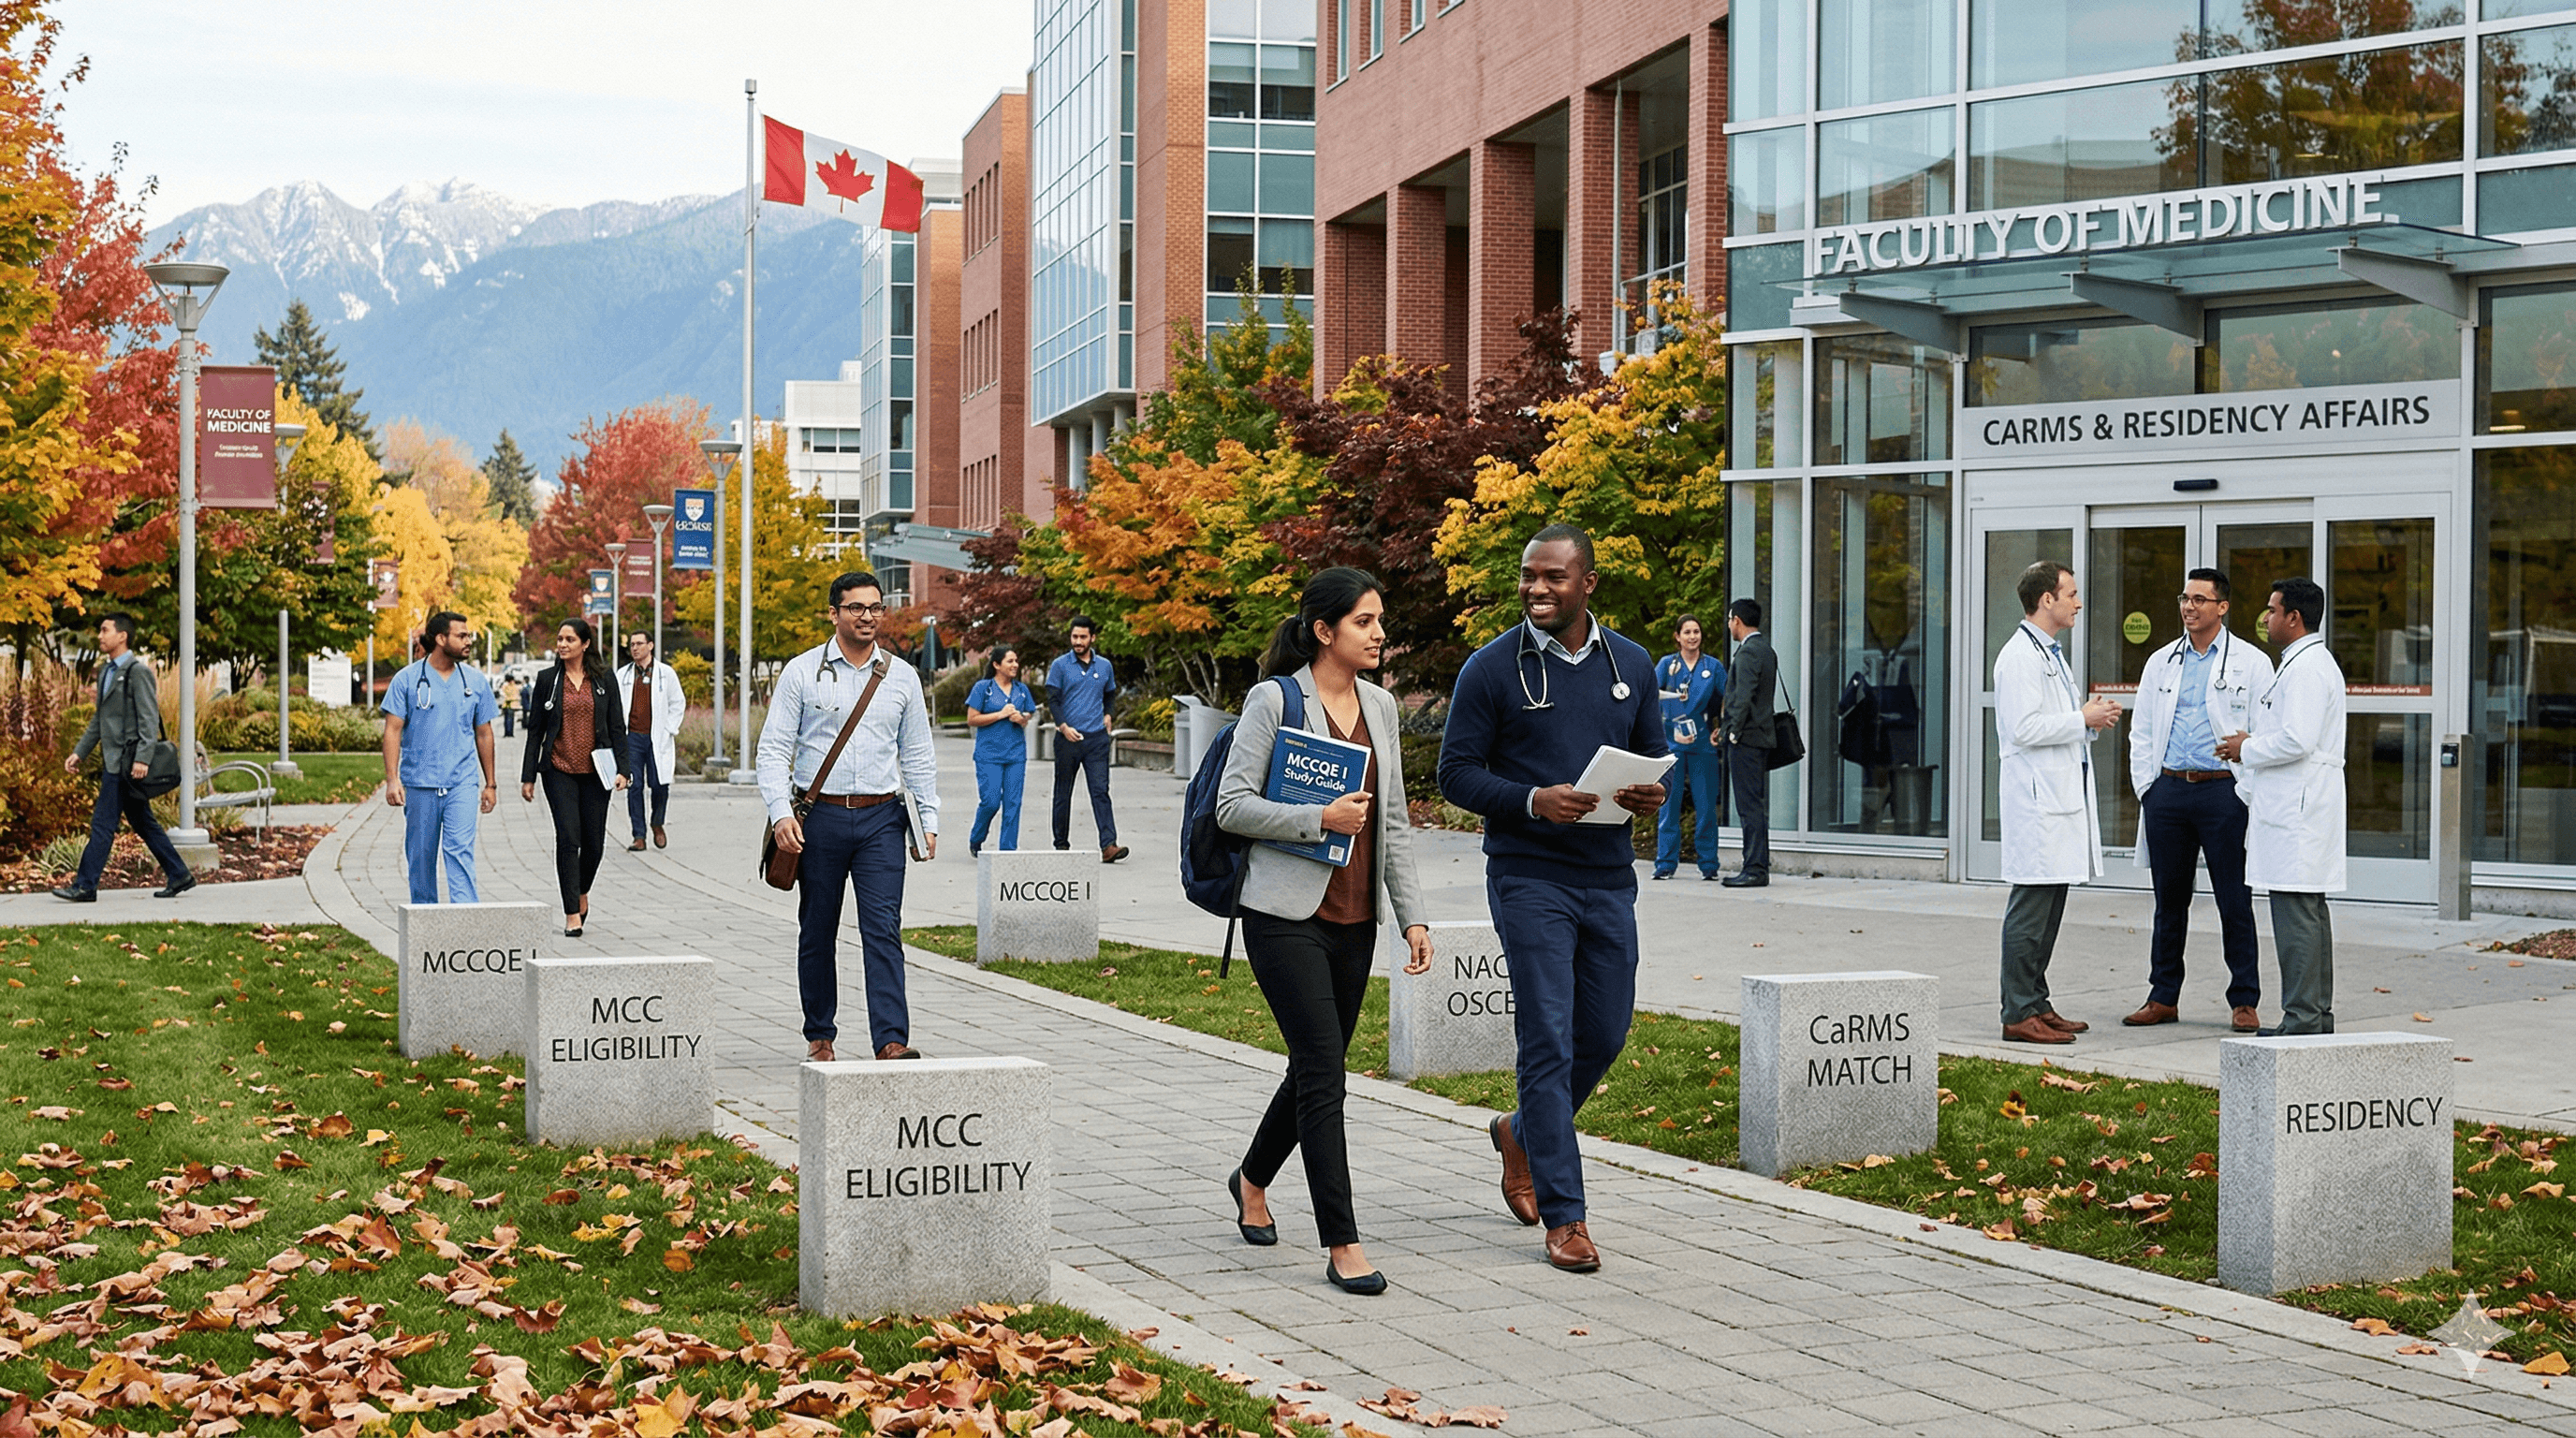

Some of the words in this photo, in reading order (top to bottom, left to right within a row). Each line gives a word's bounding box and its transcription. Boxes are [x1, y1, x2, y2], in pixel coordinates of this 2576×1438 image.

[1813, 212, 2019, 276] FACULTY
[2033, 204, 2102, 255] OF
[2117, 174, 2384, 248] MEDICINE
[207, 420, 271, 433] MEDICINE
[256, 409, 271, 420] OF
[1983, 414, 2083, 446] CARMS
[2092, 413, 2115, 440] &
[2123, 404, 2291, 439] RESIDENCY
[2299, 395, 2431, 430] AFFAIRS
[1287, 752, 1339, 777] MCCQE
[1283, 767, 1314, 785] Study
[1315, 775, 1346, 793] Guide
[1000, 880, 1079, 903] MCCQE
[1085, 880, 1091, 901] I
[423, 948, 522, 975] MCCQE
[1455, 953, 1510, 980] NAC
[592, 995, 664, 1025] MCC
[1447, 990, 1515, 1017] OSCE
[1808, 1012, 1910, 1046] CaRMS
[552, 1034, 703, 1064] ELIGIBILITY
[1808, 1054, 1911, 1088] MATCH
[2287, 1096, 2444, 1135] RESIDENCY
[898, 1112, 984, 1151] MCC
[846, 1160, 1033, 1200] ELIGIBILITY
